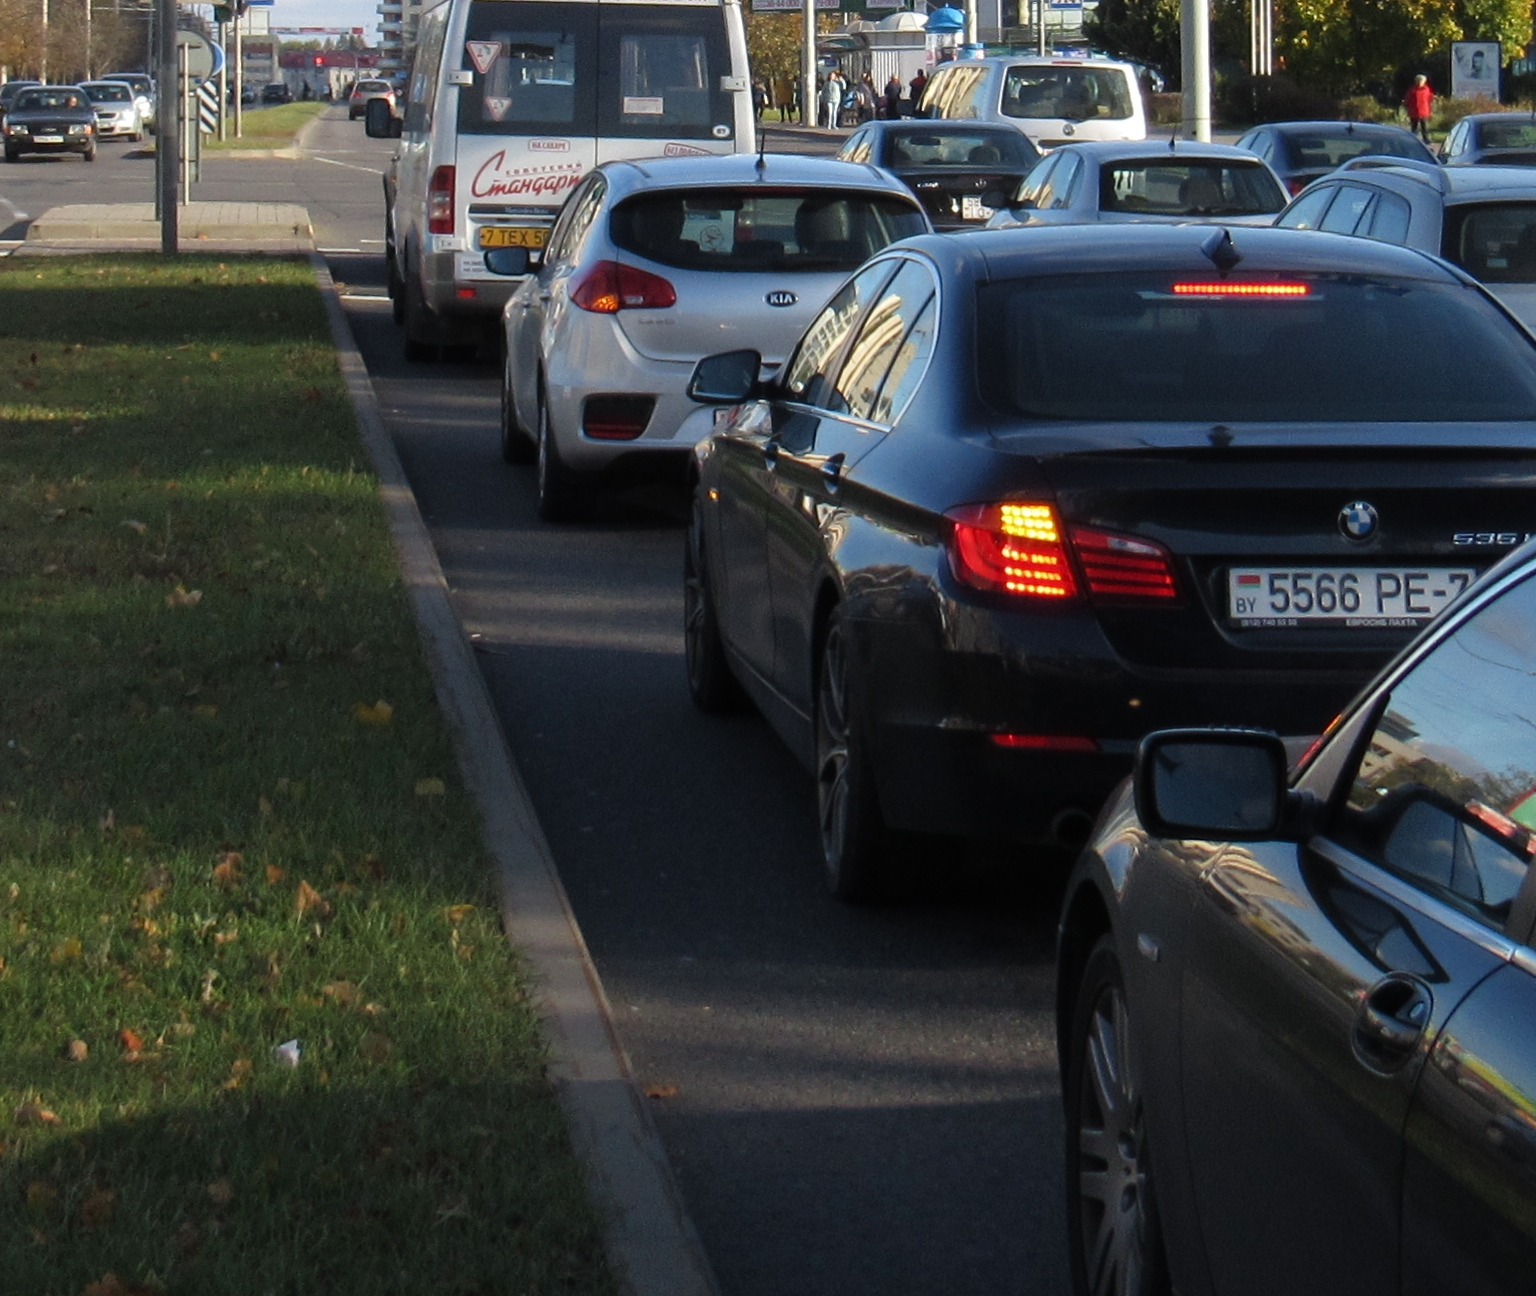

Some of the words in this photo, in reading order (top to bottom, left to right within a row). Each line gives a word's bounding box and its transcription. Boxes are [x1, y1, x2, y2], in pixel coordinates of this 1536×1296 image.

[500, 230, 529, 245] TEX
[770, 294, 794, 304] KIA
[1268, 572, 1361, 613] 5566
[1376, 571, 1471, 613] PE-7
[1235, 596, 1258, 612] BY
